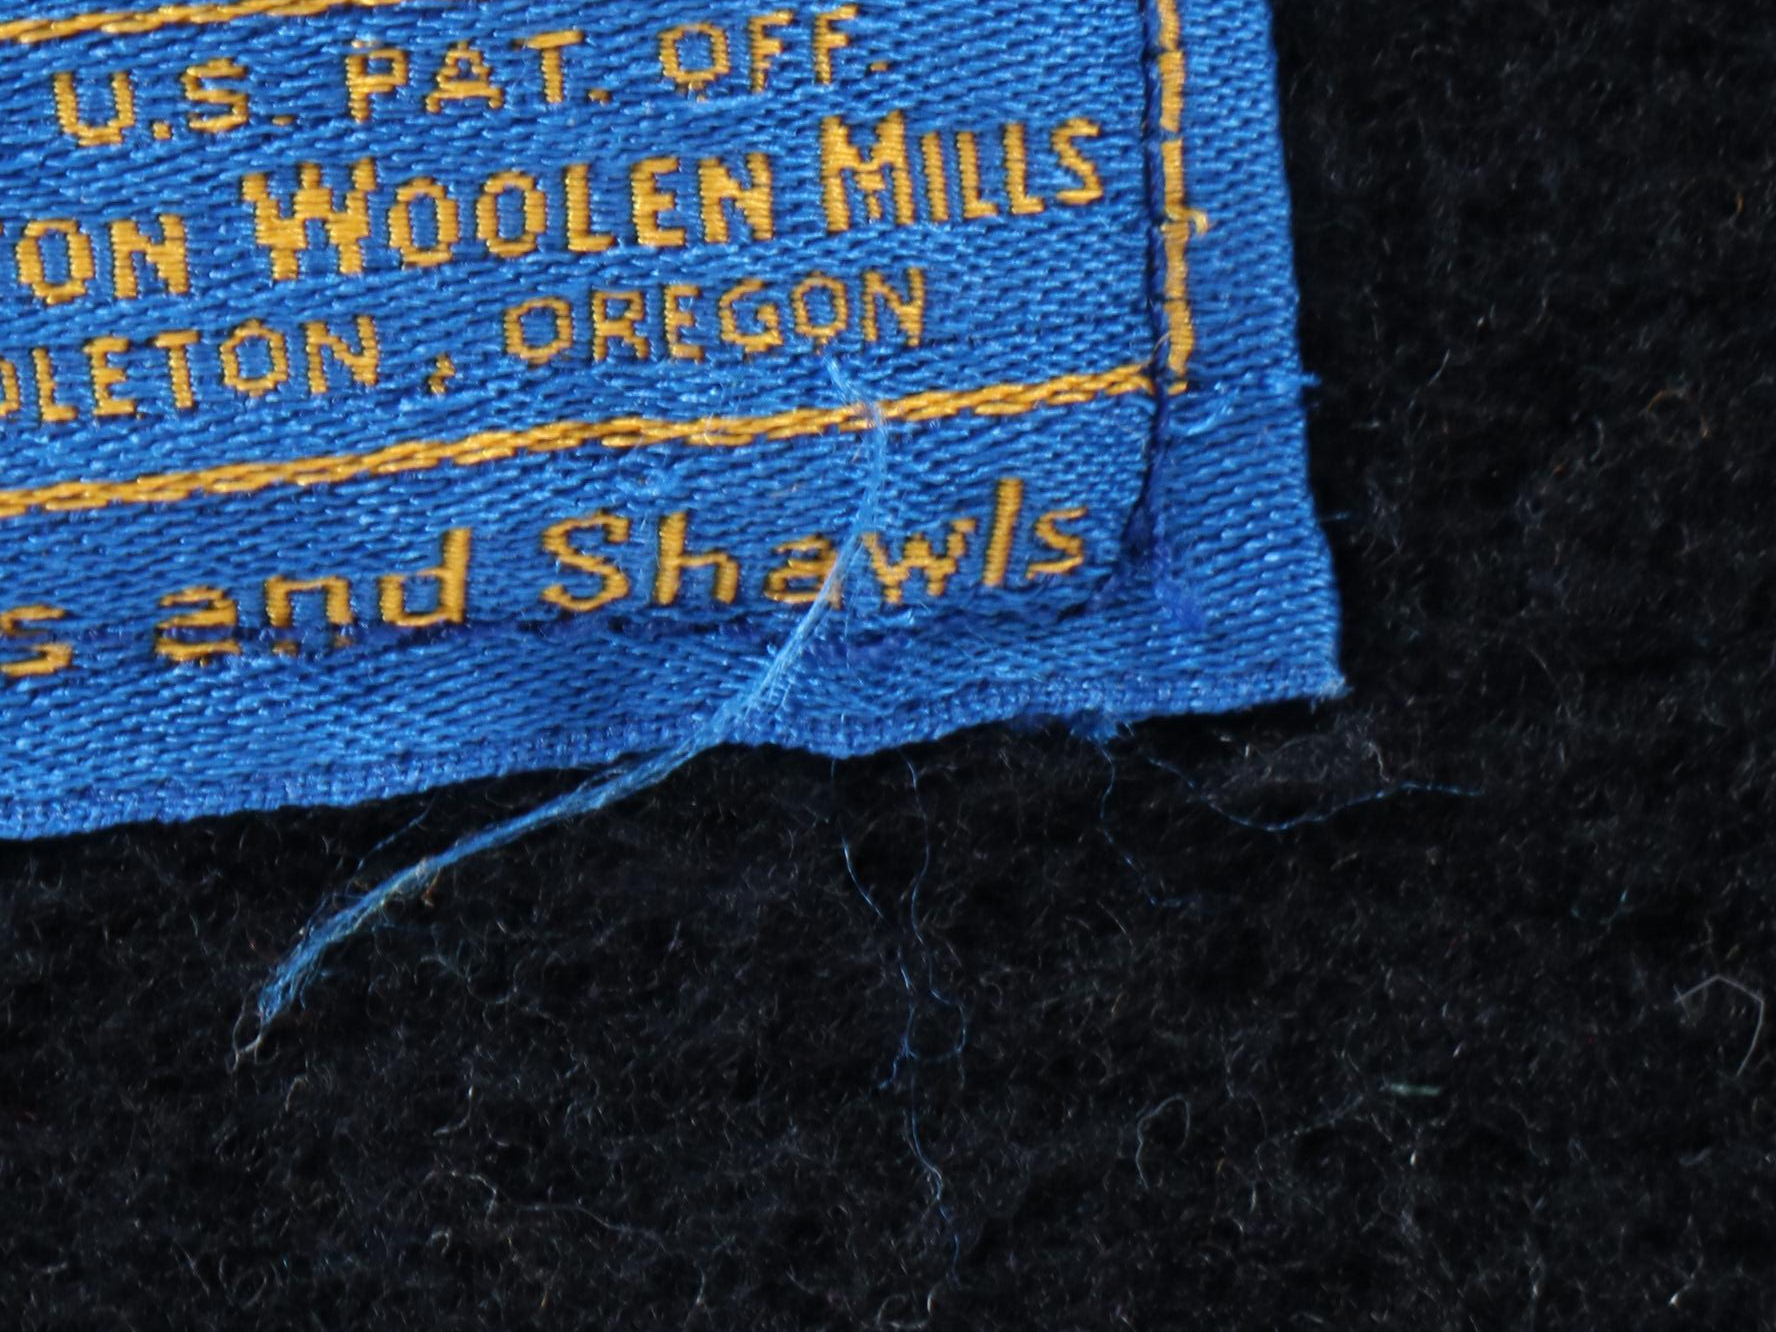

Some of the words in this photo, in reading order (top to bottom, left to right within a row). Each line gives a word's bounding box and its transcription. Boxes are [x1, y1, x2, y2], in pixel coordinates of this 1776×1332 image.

[53, 56, 296, 148] U.S.
[344, 29, 612, 123] PAT.
[659, 4, 890, 101] OFF.
[241, 152, 775, 280] WOOLEN
[822, 110, 1104, 233] MILLS
[503, 268, 926, 364] OREGON
[155, 526, 472, 667] and
[540, 476, 1088, 614] Shawls
